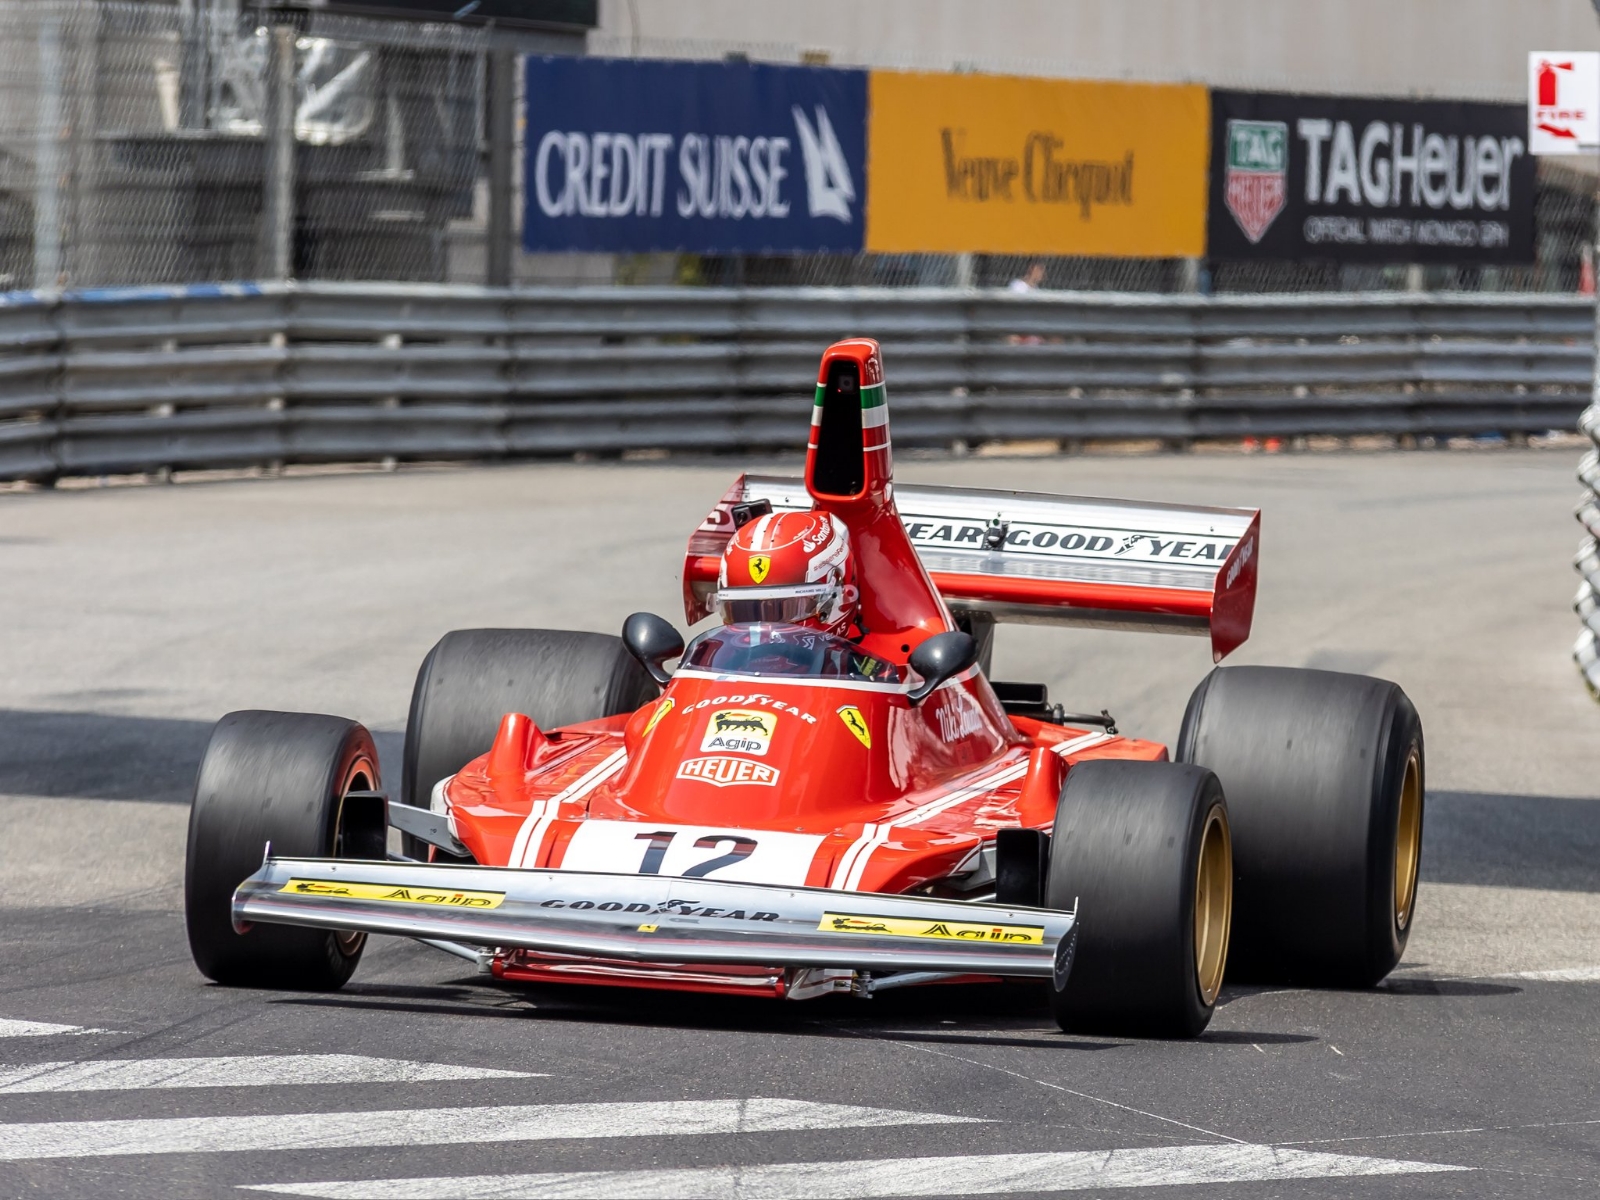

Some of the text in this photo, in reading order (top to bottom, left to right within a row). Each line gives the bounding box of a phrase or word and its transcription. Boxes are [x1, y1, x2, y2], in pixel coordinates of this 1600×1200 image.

[1537, 110, 1584, 120] FIRE
[536, 130, 791, 220] CREDIT SUISSE
[1005, 529, 1114, 551] GOOD
[708, 737, 762, 752] Agip
[684, 759, 771, 782] HEUER
[634, 831, 758, 878] 12
[540, 899, 780, 922] GOOD YEAR
